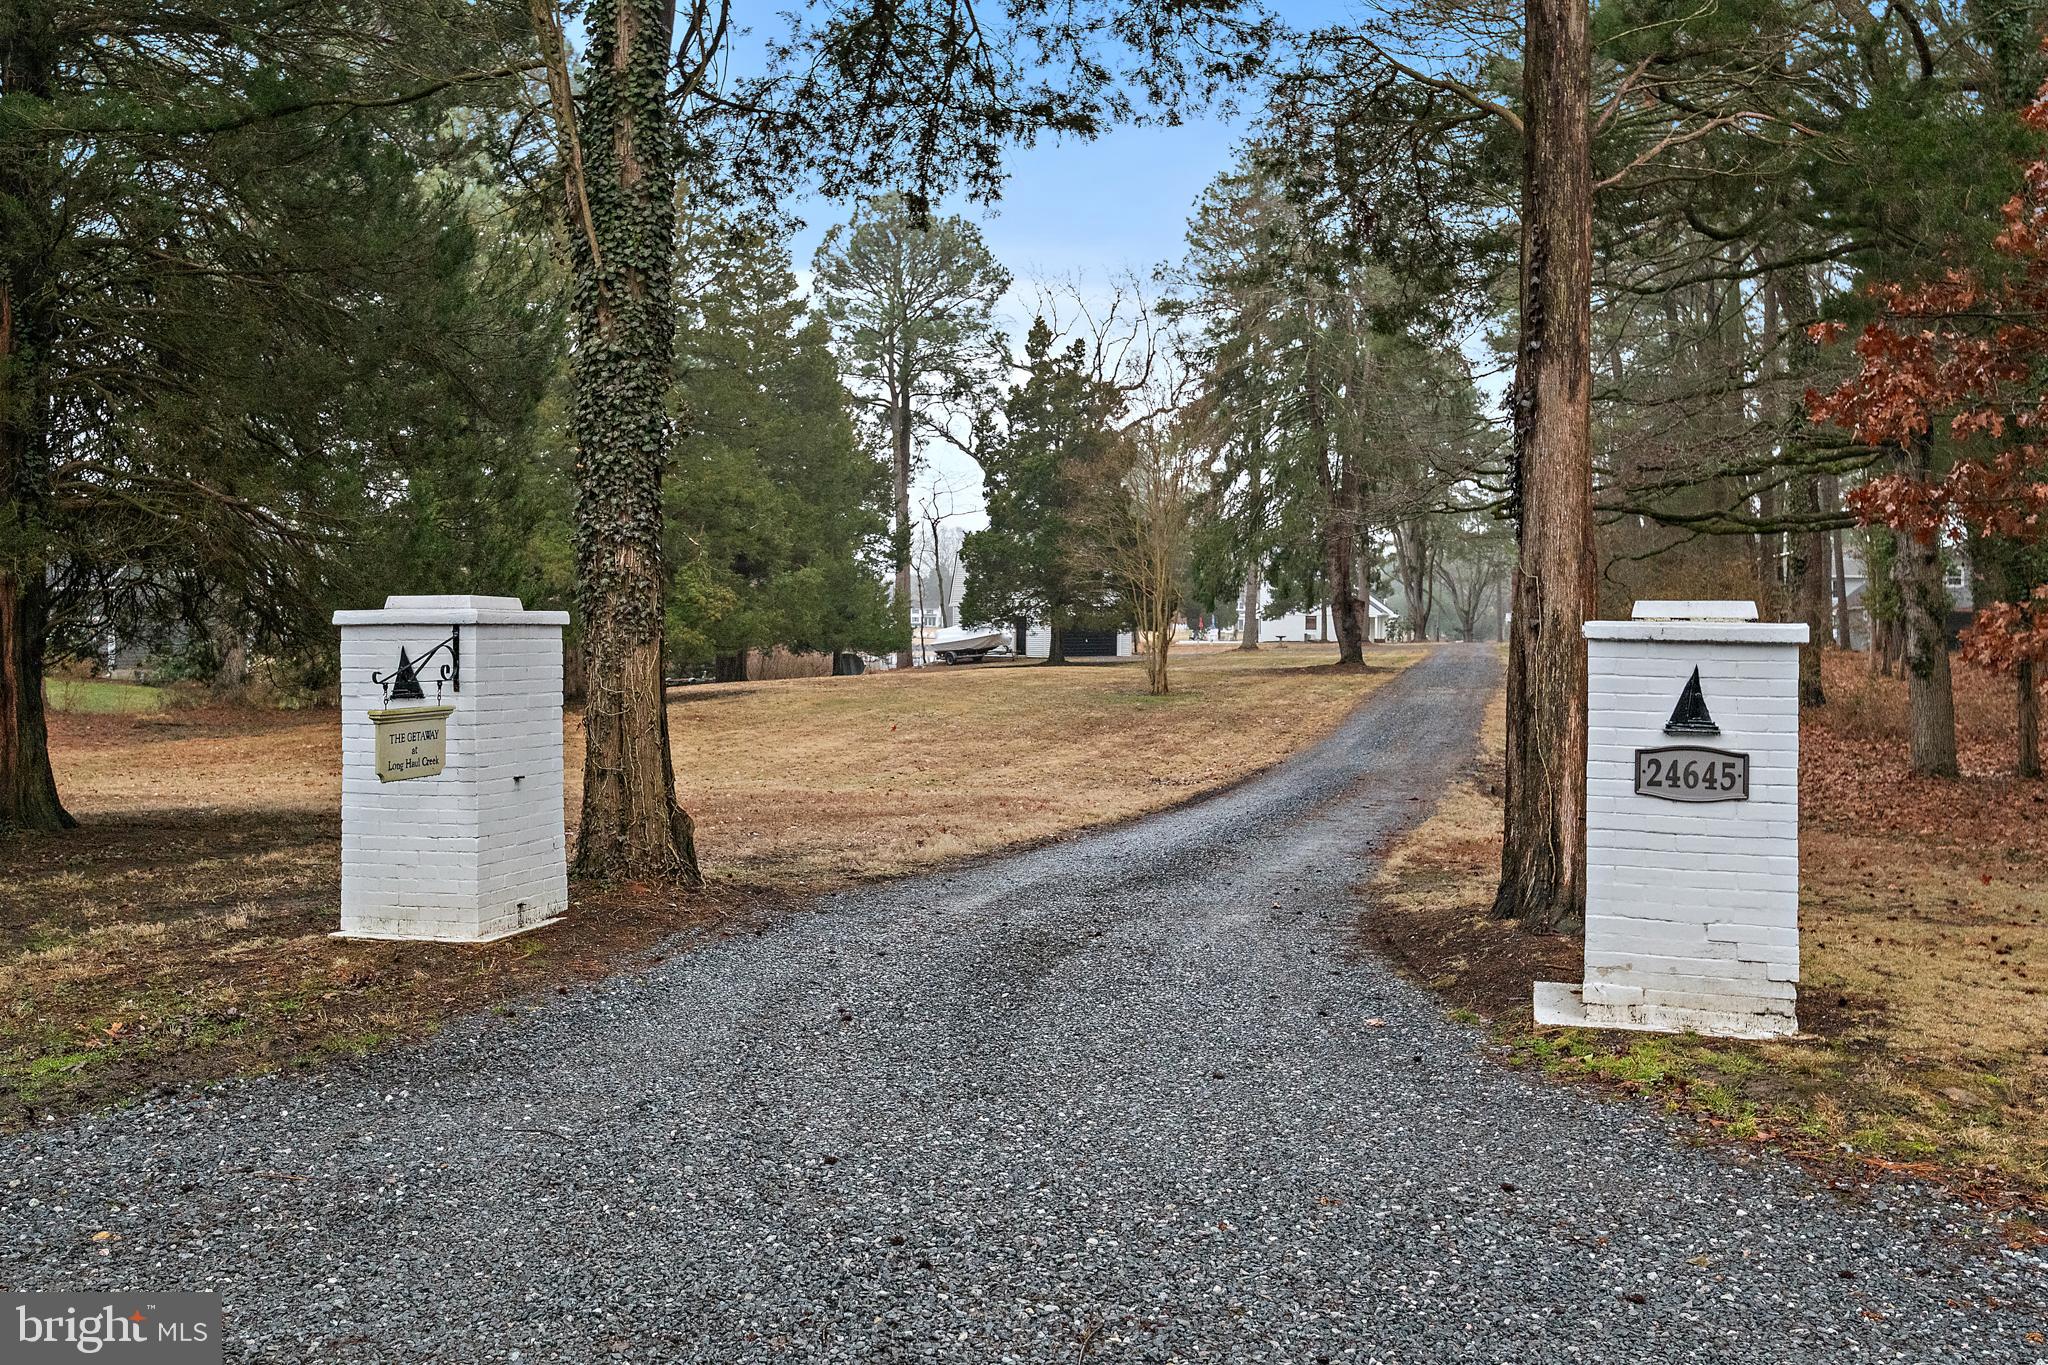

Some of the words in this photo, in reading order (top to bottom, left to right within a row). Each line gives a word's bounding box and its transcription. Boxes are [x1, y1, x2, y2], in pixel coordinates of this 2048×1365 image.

[389, 732, 405, 745] THE
[406, 729, 439, 742] GETAWAY
[411, 746, 418, 755] at
[388, 760, 404, 772] Long
[405, 757, 420, 769] Haul
[421, 755, 439, 767] Creek
[1646, 758, 1736, 791] 24645
